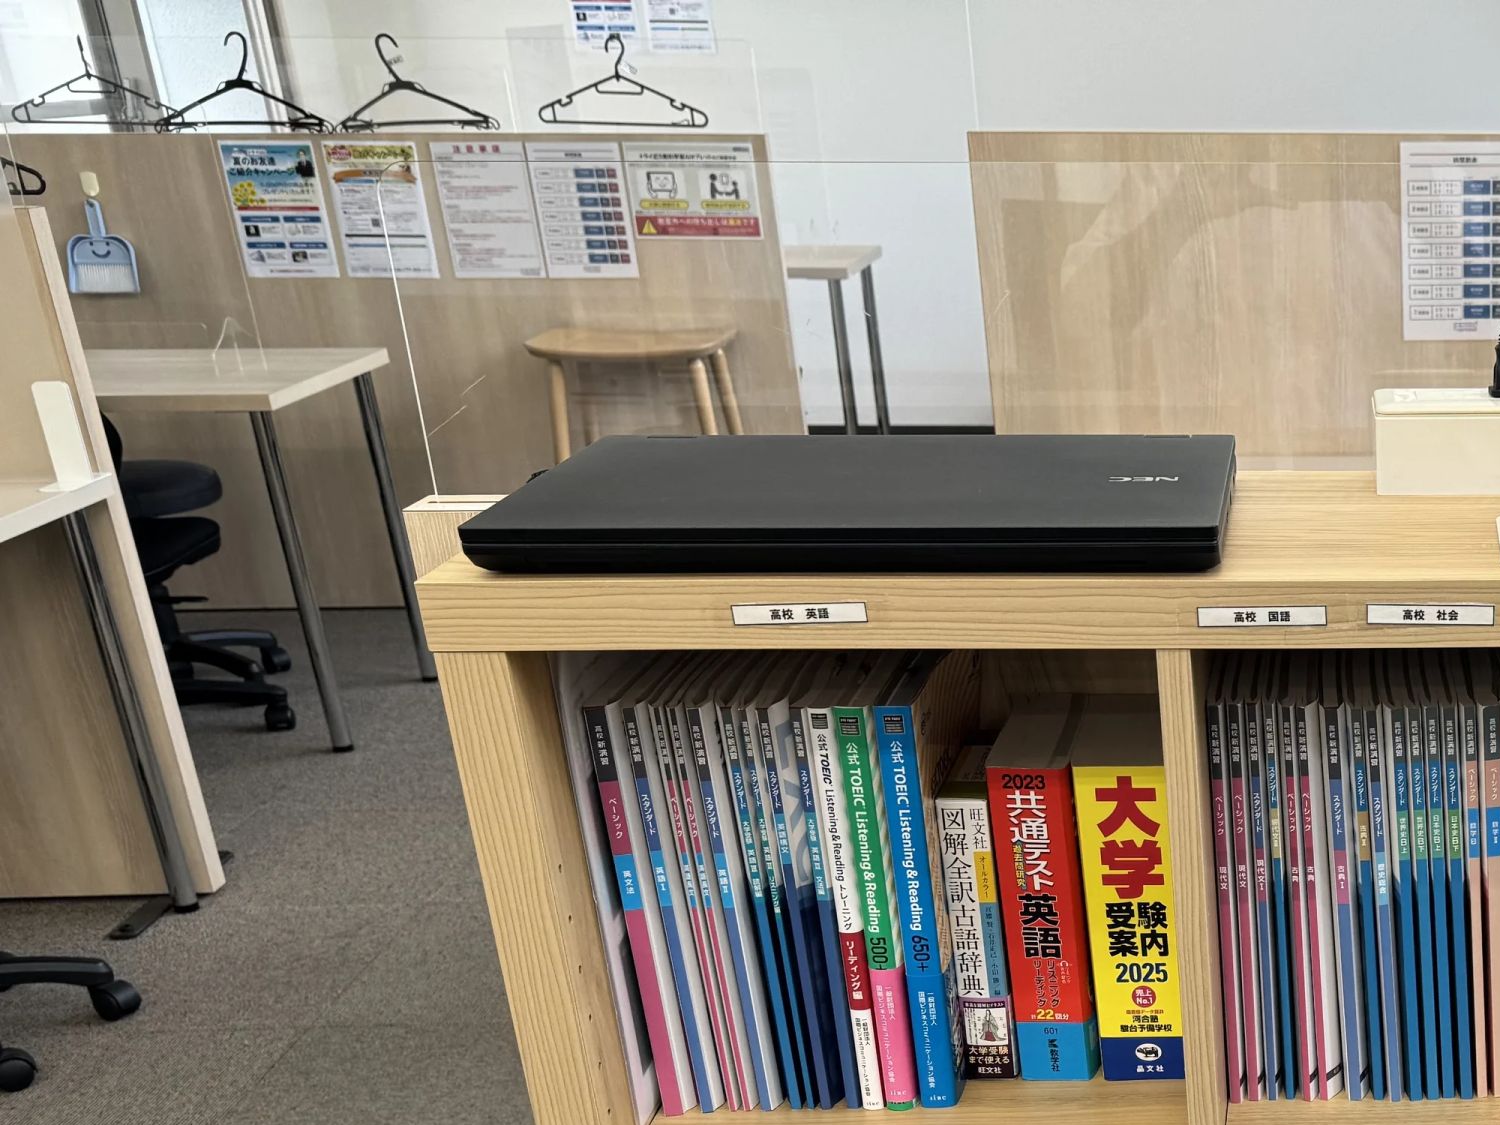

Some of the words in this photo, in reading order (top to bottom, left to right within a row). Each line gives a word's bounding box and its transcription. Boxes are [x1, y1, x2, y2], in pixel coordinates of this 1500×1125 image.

[769, 608, 794, 621] 高校
[806, 607, 830, 620] 英語
[1233, 611, 1257, 623] 高校
[1268, 611, 1291, 623] 国語
[1402, 609, 1426, 622] 高校
[1436, 609, 1459, 622] 社会
[849, 766, 866, 808] TOEIC
[893, 767, 909, 808] TOEIC
[1002, 774, 1045, 790] 2023
[608, 798, 623, 839] ベーシック
[969, 808, 987, 849] 旺文社
[1095, 776, 1165, 901] 大学
[854, 810, 871, 870] Listening
[899, 810, 915, 869] Listening
[1005, 790, 1055, 892] 共通テスト
[1219, 865, 1228, 891] 現代文
[866, 884, 880, 933] Reading
[907, 882, 922, 932] Reading
[941, 808, 984, 997] 図解全訳古語辞典
[1105, 901, 1168, 930] 受験
[1019, 893, 1063, 960] 英語
[1108, 930, 1170, 958] 案内
[912, 934, 928, 973] 650+
[1116, 963, 1168, 983] 2025
[1033, 961, 1046, 1008] リーディング
[1047, 961, 1060, 1007] リスニング
[1120, 1024, 1173, 1032] 駿台予備学校
[1132, 1015, 1159, 1023] 河合塾
